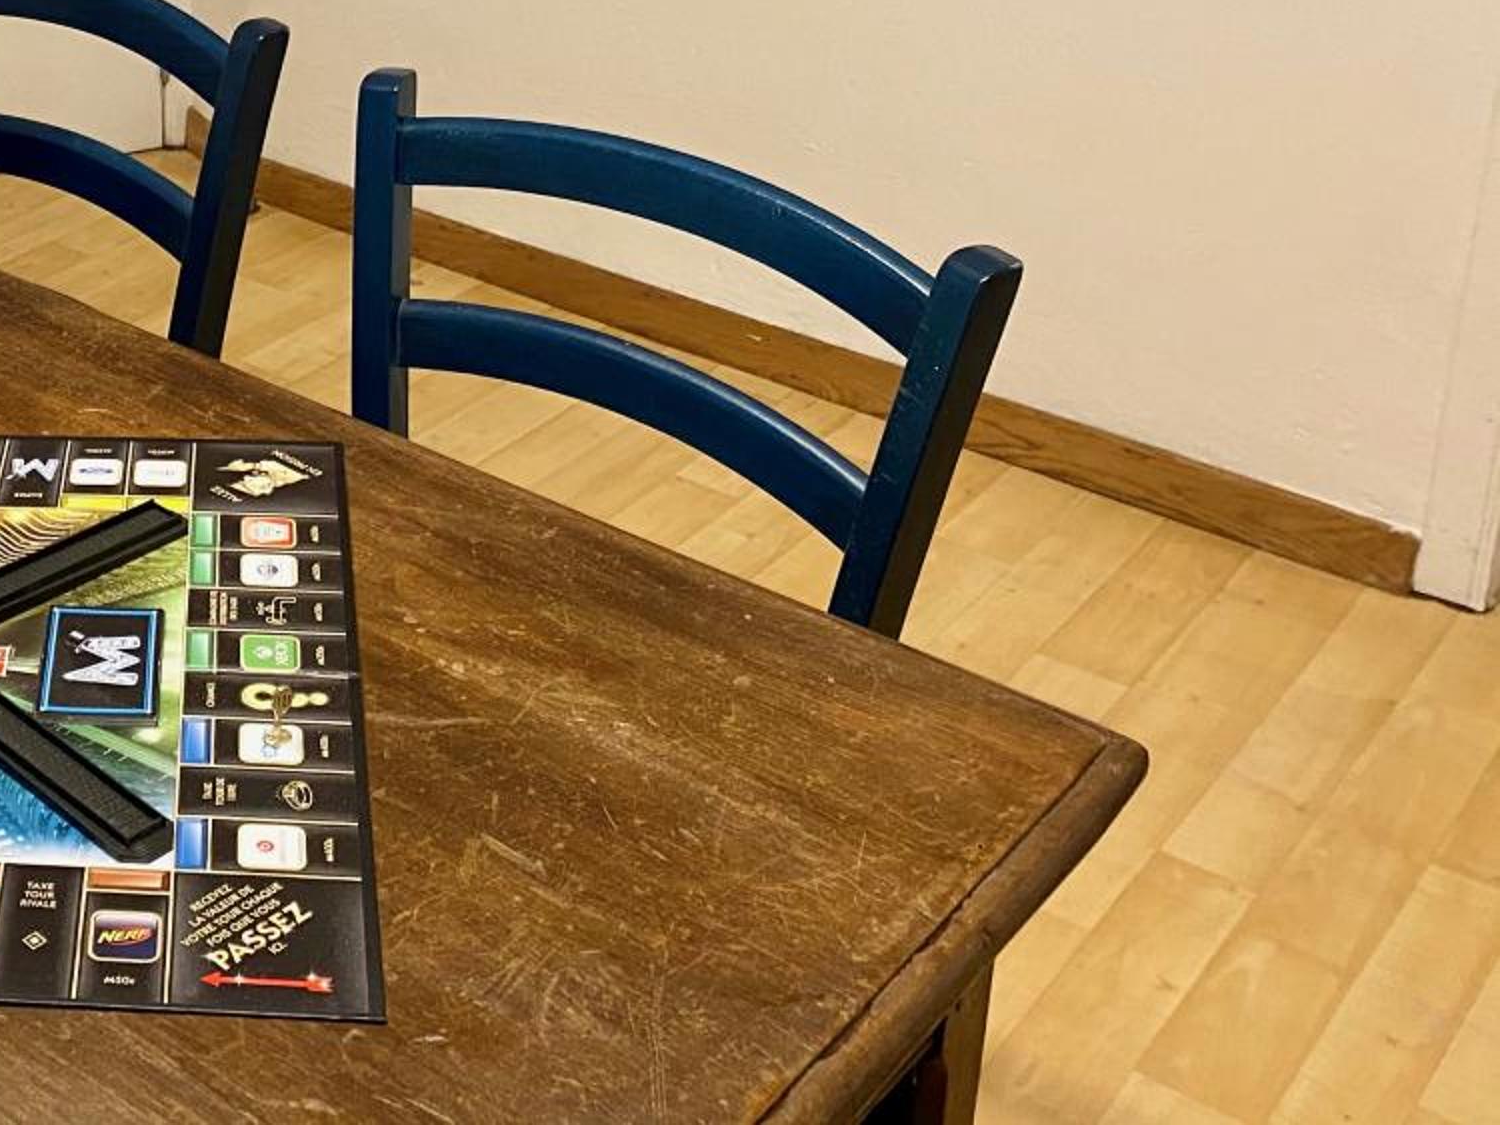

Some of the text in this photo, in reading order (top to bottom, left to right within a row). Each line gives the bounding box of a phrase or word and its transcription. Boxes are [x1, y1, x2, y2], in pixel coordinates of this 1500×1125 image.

[27, 881, 55, 890] TAXE
[25, 890, 55, 899] TOUR
[250, 898, 282, 919] VOUS
[97, 928, 150, 945] NERF
[203, 901, 314, 971] PASSEZ
